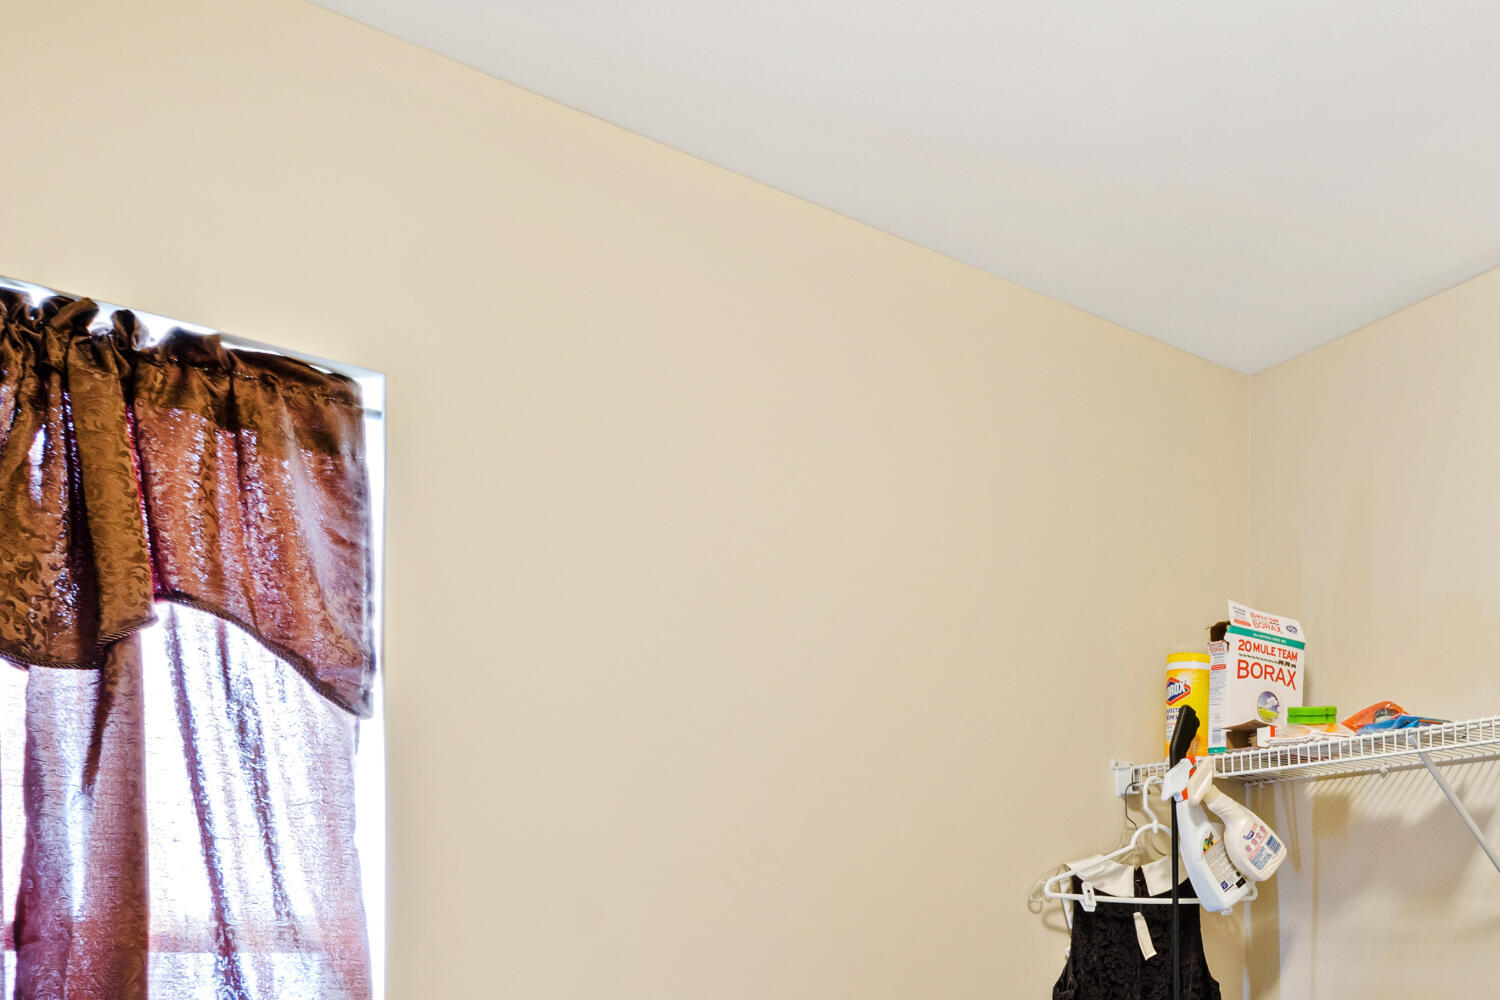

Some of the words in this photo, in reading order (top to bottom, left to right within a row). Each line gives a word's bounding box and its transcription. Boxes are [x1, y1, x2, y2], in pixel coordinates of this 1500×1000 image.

[1238, 639, 1252, 652] 20
[1253, 642, 1276, 657] MULE
[1277, 648, 1298, 662] TEAM
[1237, 659, 1296, 691] BORAX
